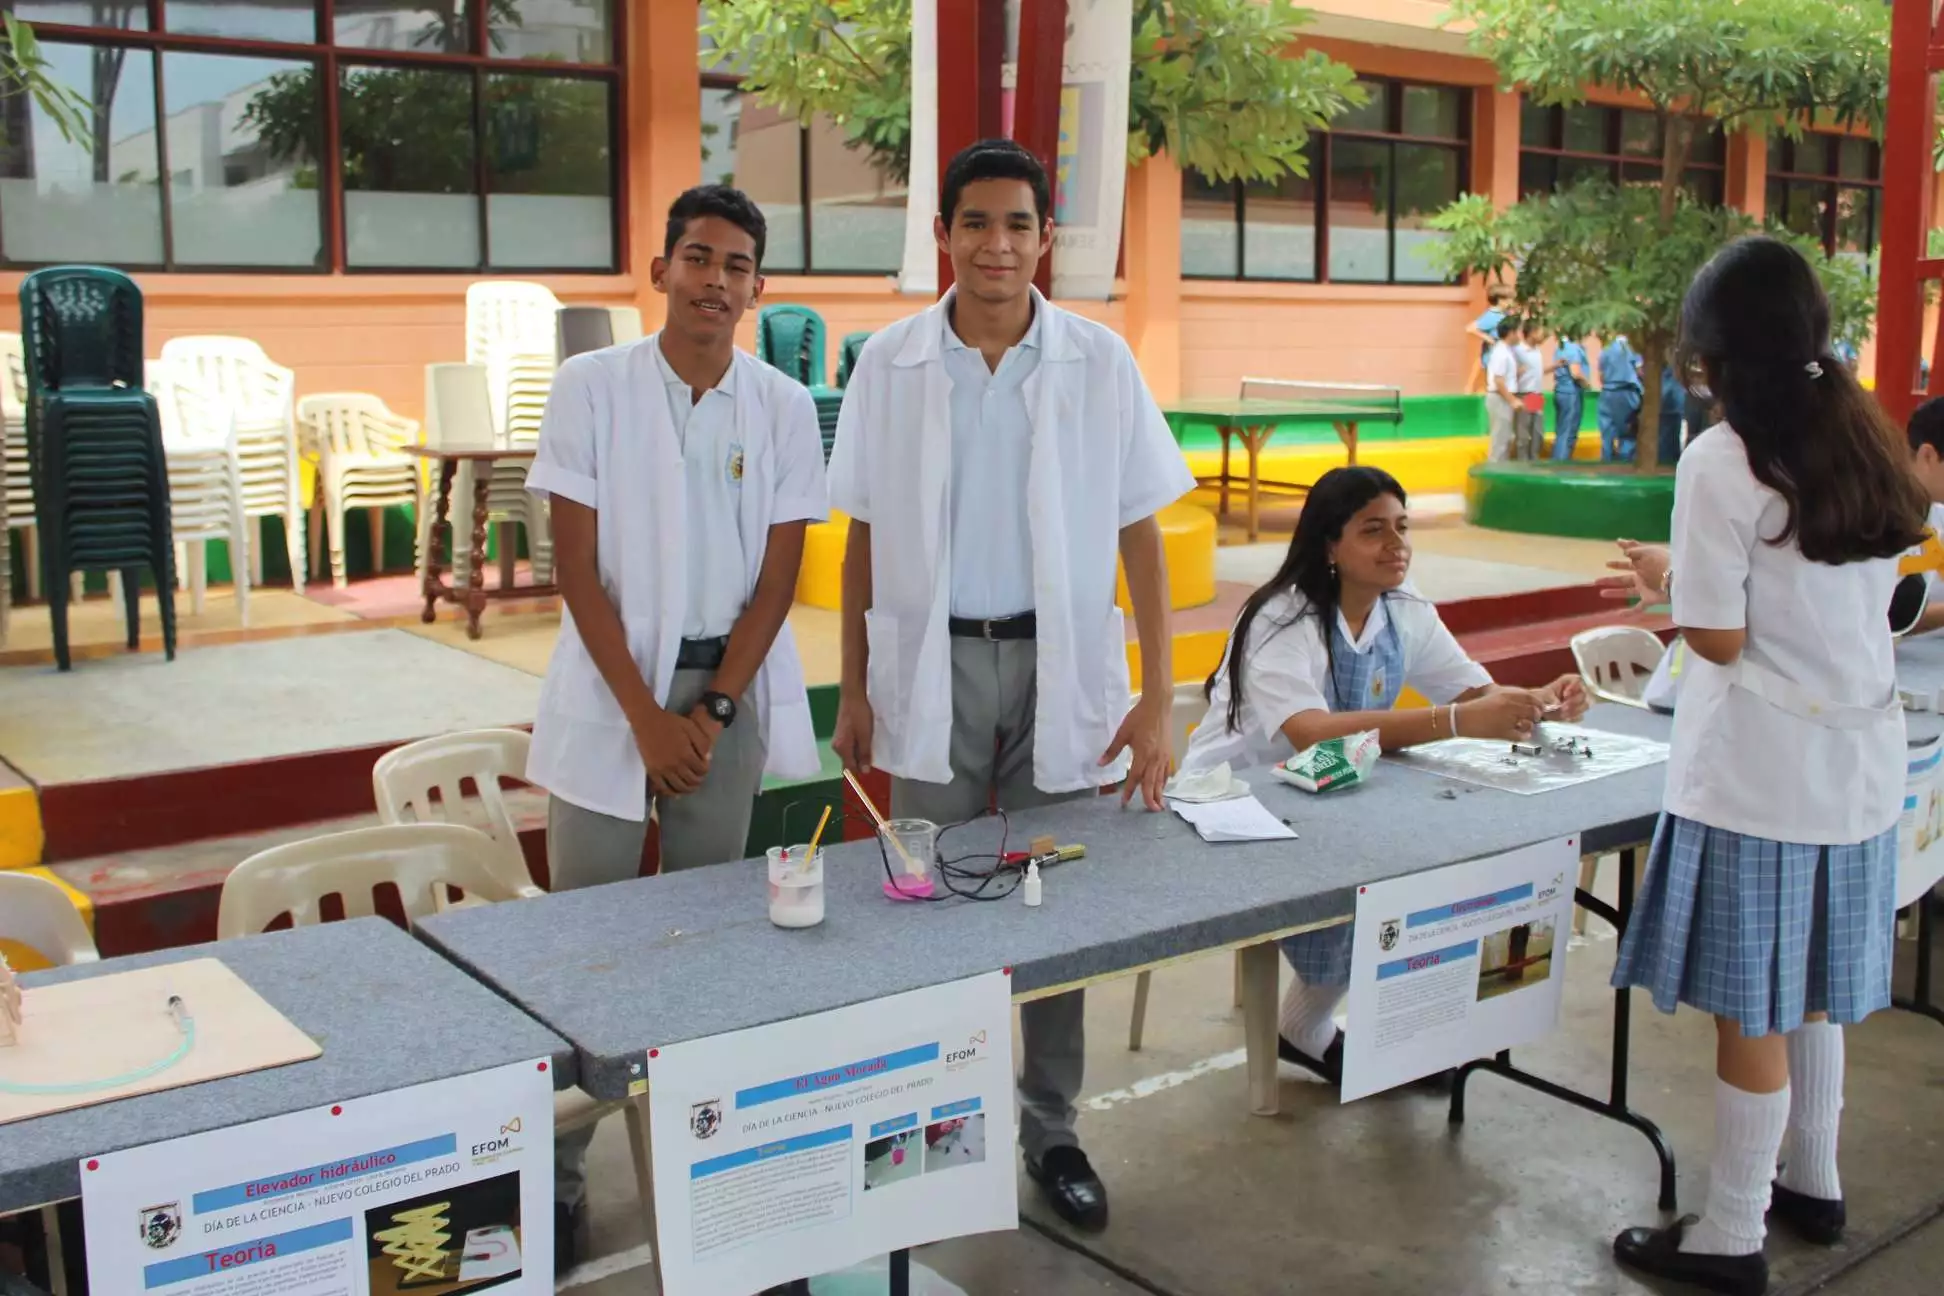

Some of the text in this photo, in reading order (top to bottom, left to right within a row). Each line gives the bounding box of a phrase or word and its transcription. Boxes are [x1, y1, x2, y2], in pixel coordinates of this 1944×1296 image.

[945, 1048, 976, 1063] EFQM
[759, 1119, 770, 1129] DE
[772, 1116, 783, 1126] LA
[784, 1108, 818, 1122] CIENCIA
[824, 1098, 854, 1113] NUEVO
[855, 1088, 889, 1105] COLEGIO
[890, 1085, 904, 1095] DEL
[906, 1077, 934, 1090] PRADO
[471, 1137, 509, 1156] EFQM
[245, 1172, 316, 1198] Elevador
[320, 1153, 396, 1180] hidráulico
[204, 1219, 224, 1234] DÍA
[226, 1216, 241, 1229] DE
[243, 1213, 257, 1224] LA
[260, 1201, 305, 1220] CIENCIA
[314, 1190, 352, 1207] NUEVO
[354, 1177, 401, 1197] COLEGIO
[404, 1173, 422, 1185] DEL
[425, 1162, 460, 1179] PRADO
[204, 1240, 277, 1271] Teoría
